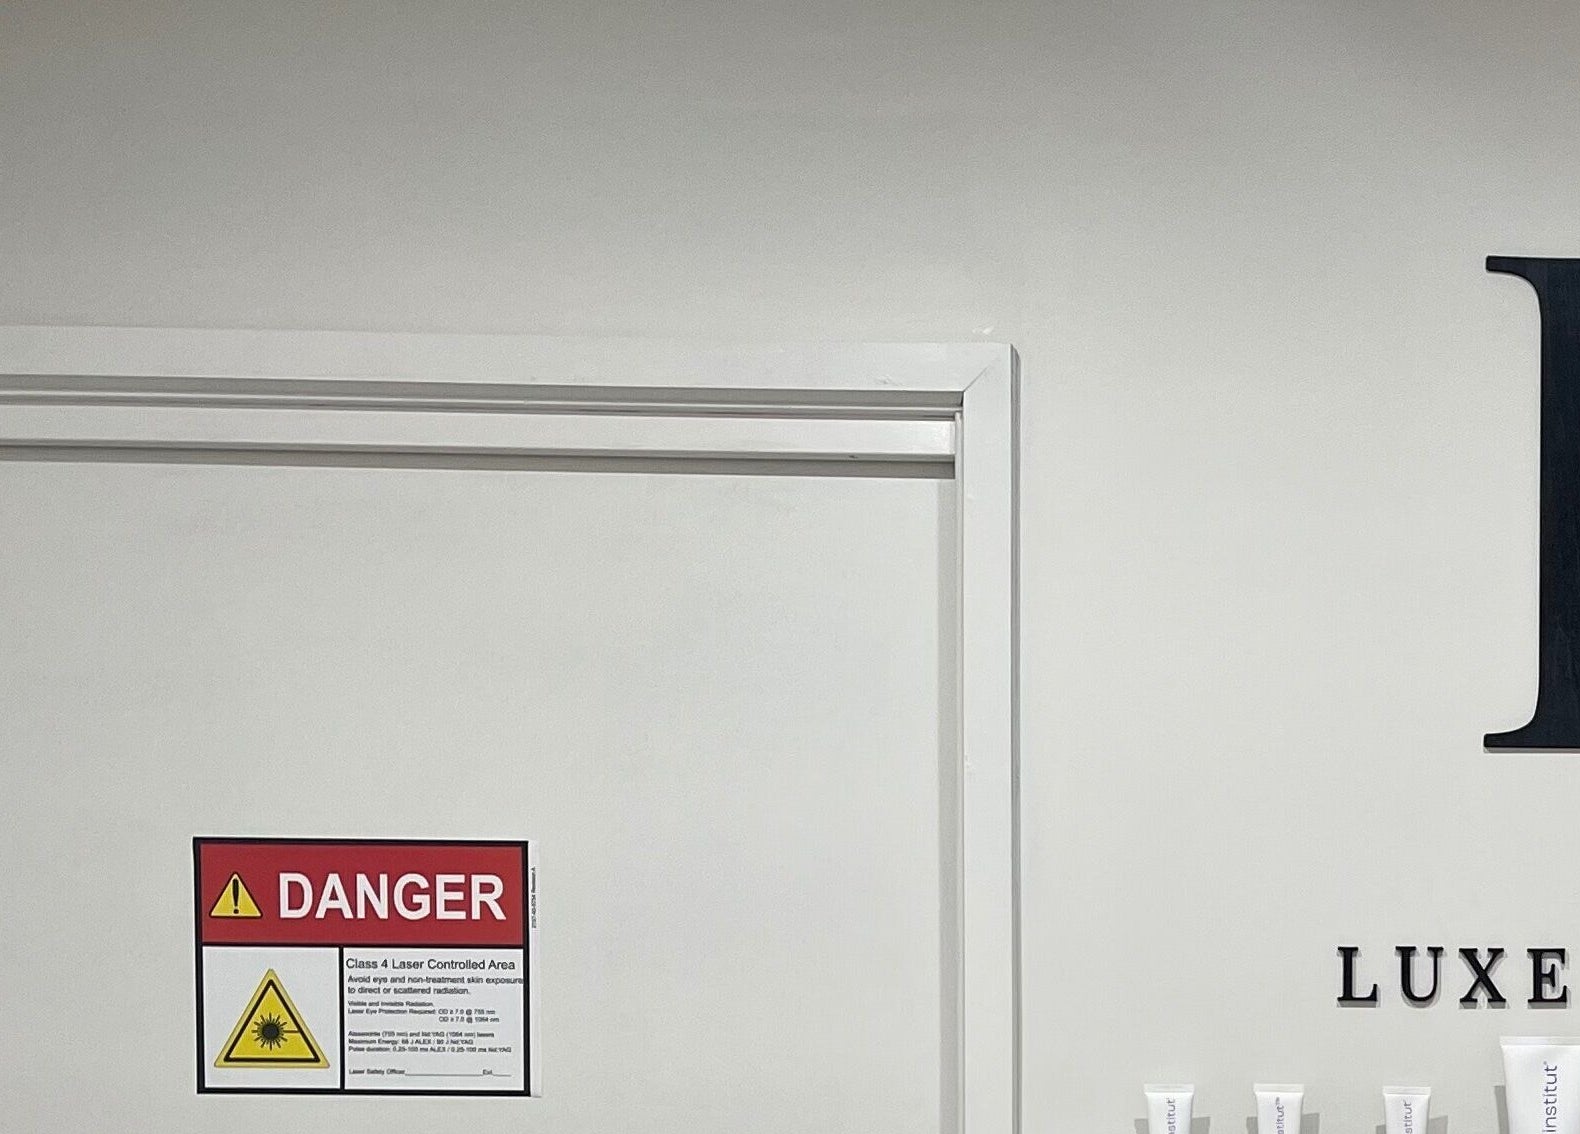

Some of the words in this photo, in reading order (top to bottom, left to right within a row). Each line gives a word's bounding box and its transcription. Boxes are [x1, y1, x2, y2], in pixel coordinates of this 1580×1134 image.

[279, 873, 507, 920] DANGER
[346, 958, 378, 969] Class
[381, 959, 388, 969] 4
[392, 958, 425, 969] Laser
[427, 959, 485, 970] Controlled
[488, 960, 516, 970] Area
[348, 975, 370, 983] Avoid
[373, 977, 388, 985] eye
[408, 976, 465, 984] non-treatment
[1336, 946, 1567, 1003] LUXE
[348, 986, 356, 994] to
[358, 986, 380, 994] direct
